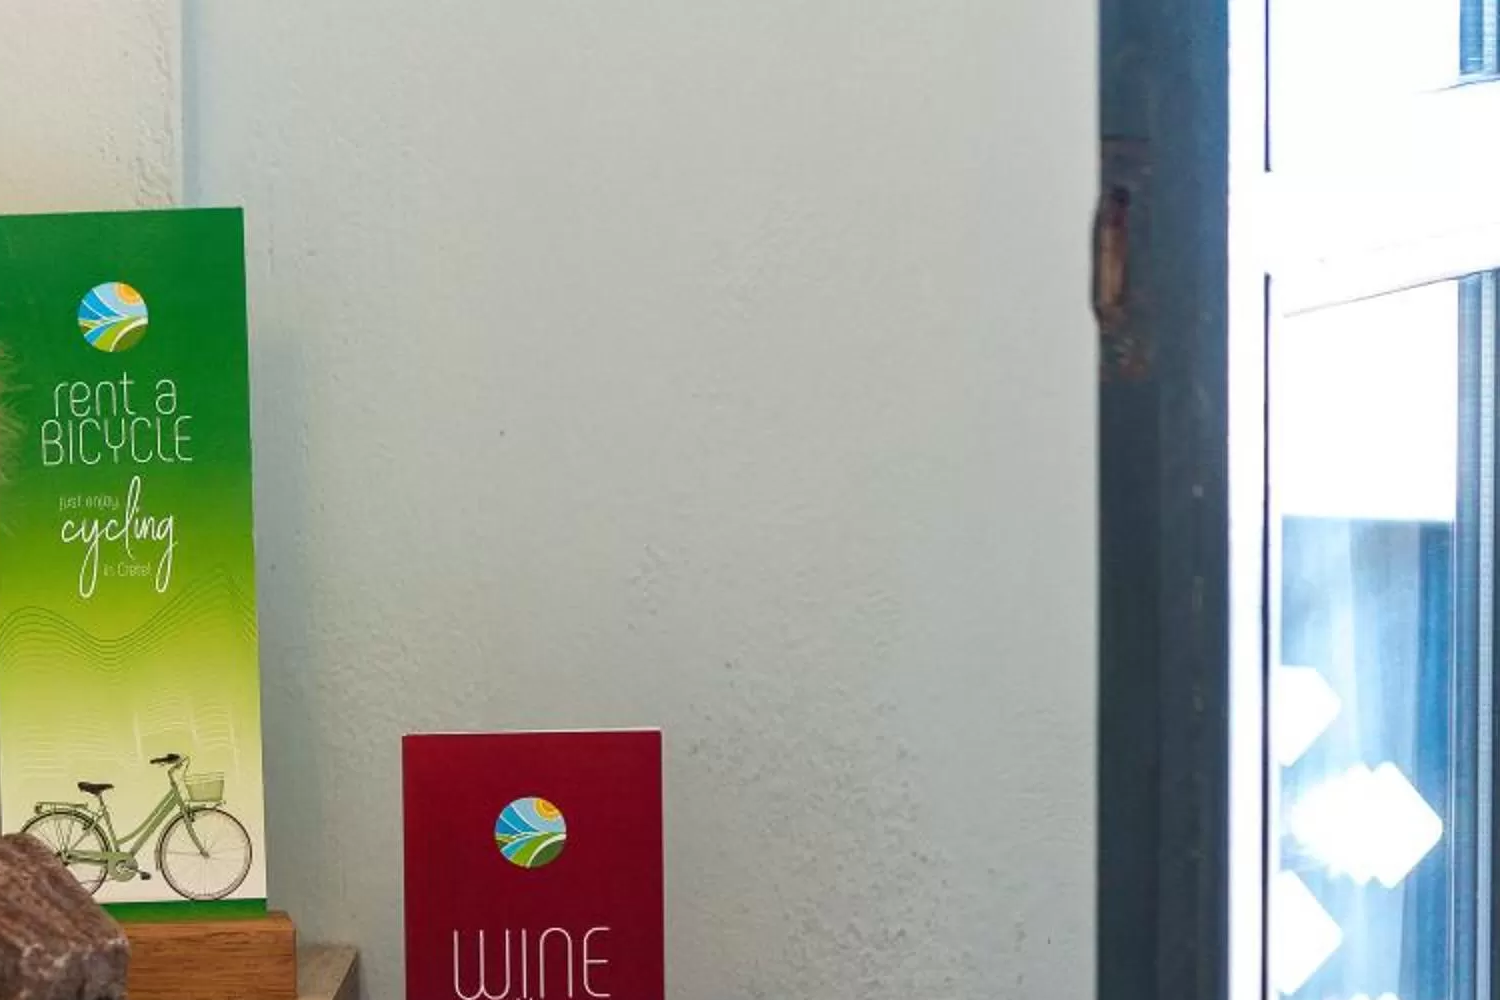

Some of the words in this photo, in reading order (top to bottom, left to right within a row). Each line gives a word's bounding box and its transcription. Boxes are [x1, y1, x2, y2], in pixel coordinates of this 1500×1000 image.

[53, 370, 137, 418] rent
[155, 378, 178, 416] a
[40, 414, 194, 467] BICYCLE
[59, 495, 82, 512] just
[60, 475, 179, 599] cycling
